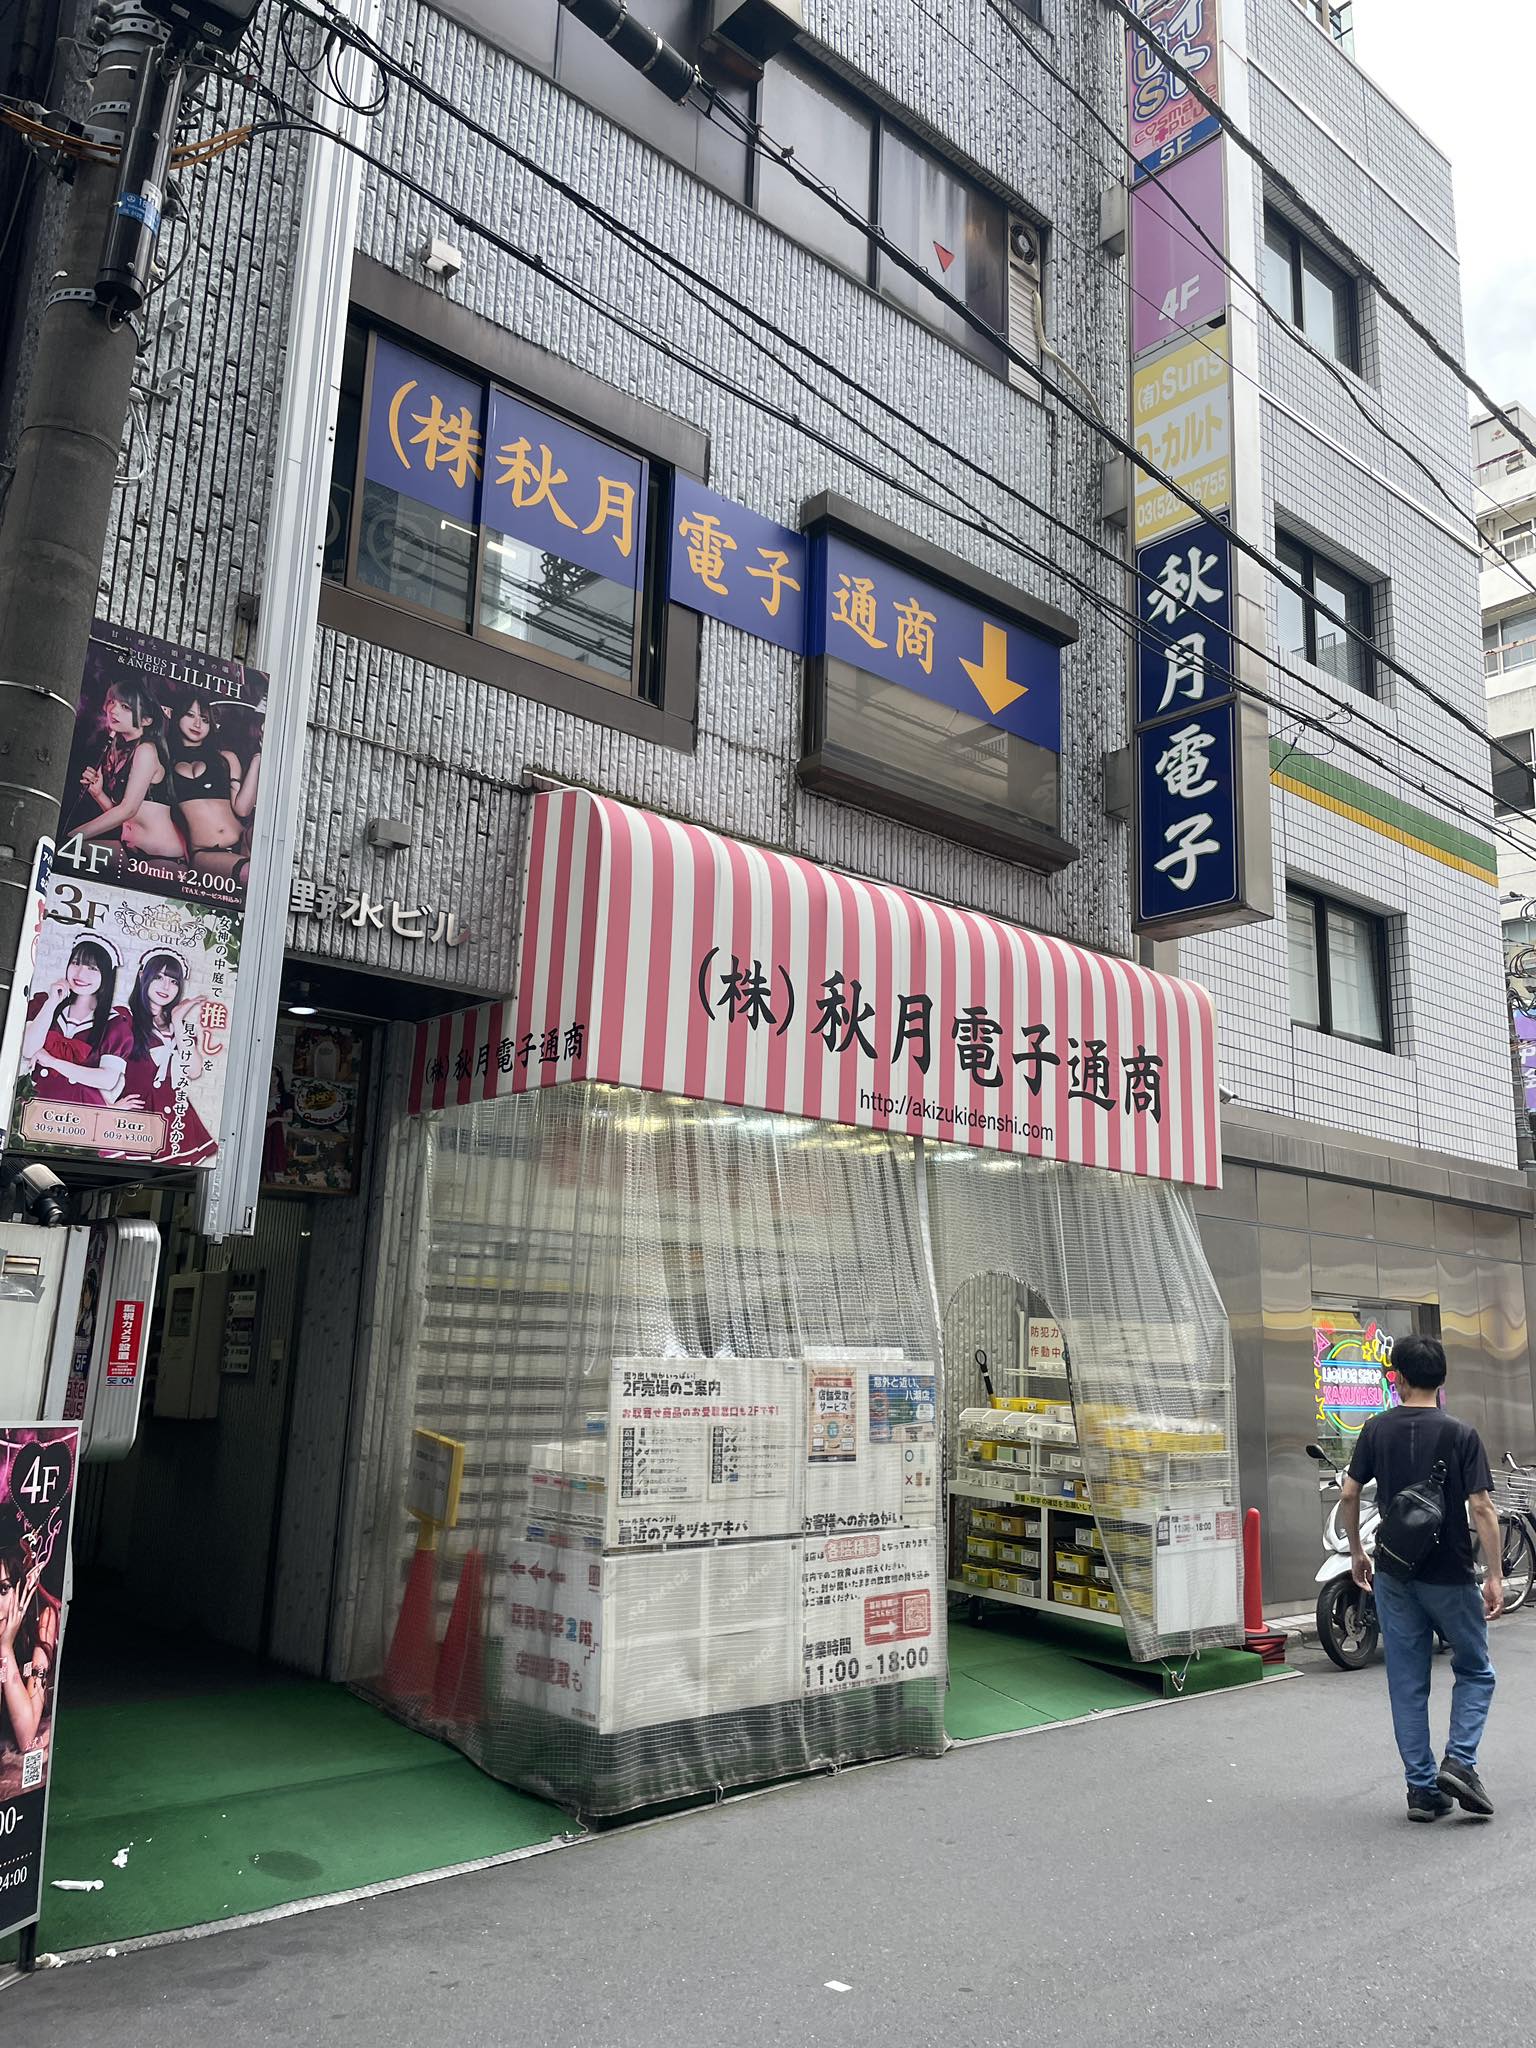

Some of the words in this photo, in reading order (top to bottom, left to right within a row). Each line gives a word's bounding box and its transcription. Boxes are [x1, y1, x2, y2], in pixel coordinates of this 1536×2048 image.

[1160, 129, 1194, 165] 5F
[1158, 274, 1200, 322] 4F
[118, 656, 126, 664] &
[127, 660, 166, 677] ANGEL
[170, 662, 242, 700] LILITH
[1146, 546, 1225, 891] 秋月電子
[57, 832, 113, 874] 4F
[127, 858, 174, 882] 30min
[178, 870, 243, 894] ¥2,000-
[54, 883, 111, 930] 3F
[290, 878, 471, 947] 野水ビル
[211, 916, 232, 998] 女神の中庭で
[425, 1021, 585, 1085] (株)秋月電子通商
[698, 946, 1164, 1124] (株)秋月電子通商
[34, 1122, 54, 1133] 30分
[57, 1126, 86, 1136] ¥1,000
[43, 1110, 80, 1124] Cafe
[116, 1118, 144, 1131] Bar
[859, 1088, 1055, 1143] http://akizukidenshi.com
[103, 1130, 122, 1140] 60分
[125, 1133, 154, 1144] ¥3,000
[117, 1304, 136, 1361] 監視カメラ設置
[75, 1354, 87, 1371] 5F
[1030, 1346, 1061, 1359] 作動中
[623, 1379, 721, 1397] 2F売場のご案内
[1322, 1367, 1358, 1384] LIQUOR
[1358, 1369, 1382, 1384] SHOP
[820, 1402, 848, 1412] サービス
[1323, 1386, 1382, 1405] KAKUYASU
[20, 1455, 60, 1504] 4F
[801, 1511, 903, 1531] お客様へのおねがい
[803, 1637, 852, 1661] 営業時間
[805, 1657, 860, 1688] 11:00
[876, 1646, 929, 1675] 18:00
